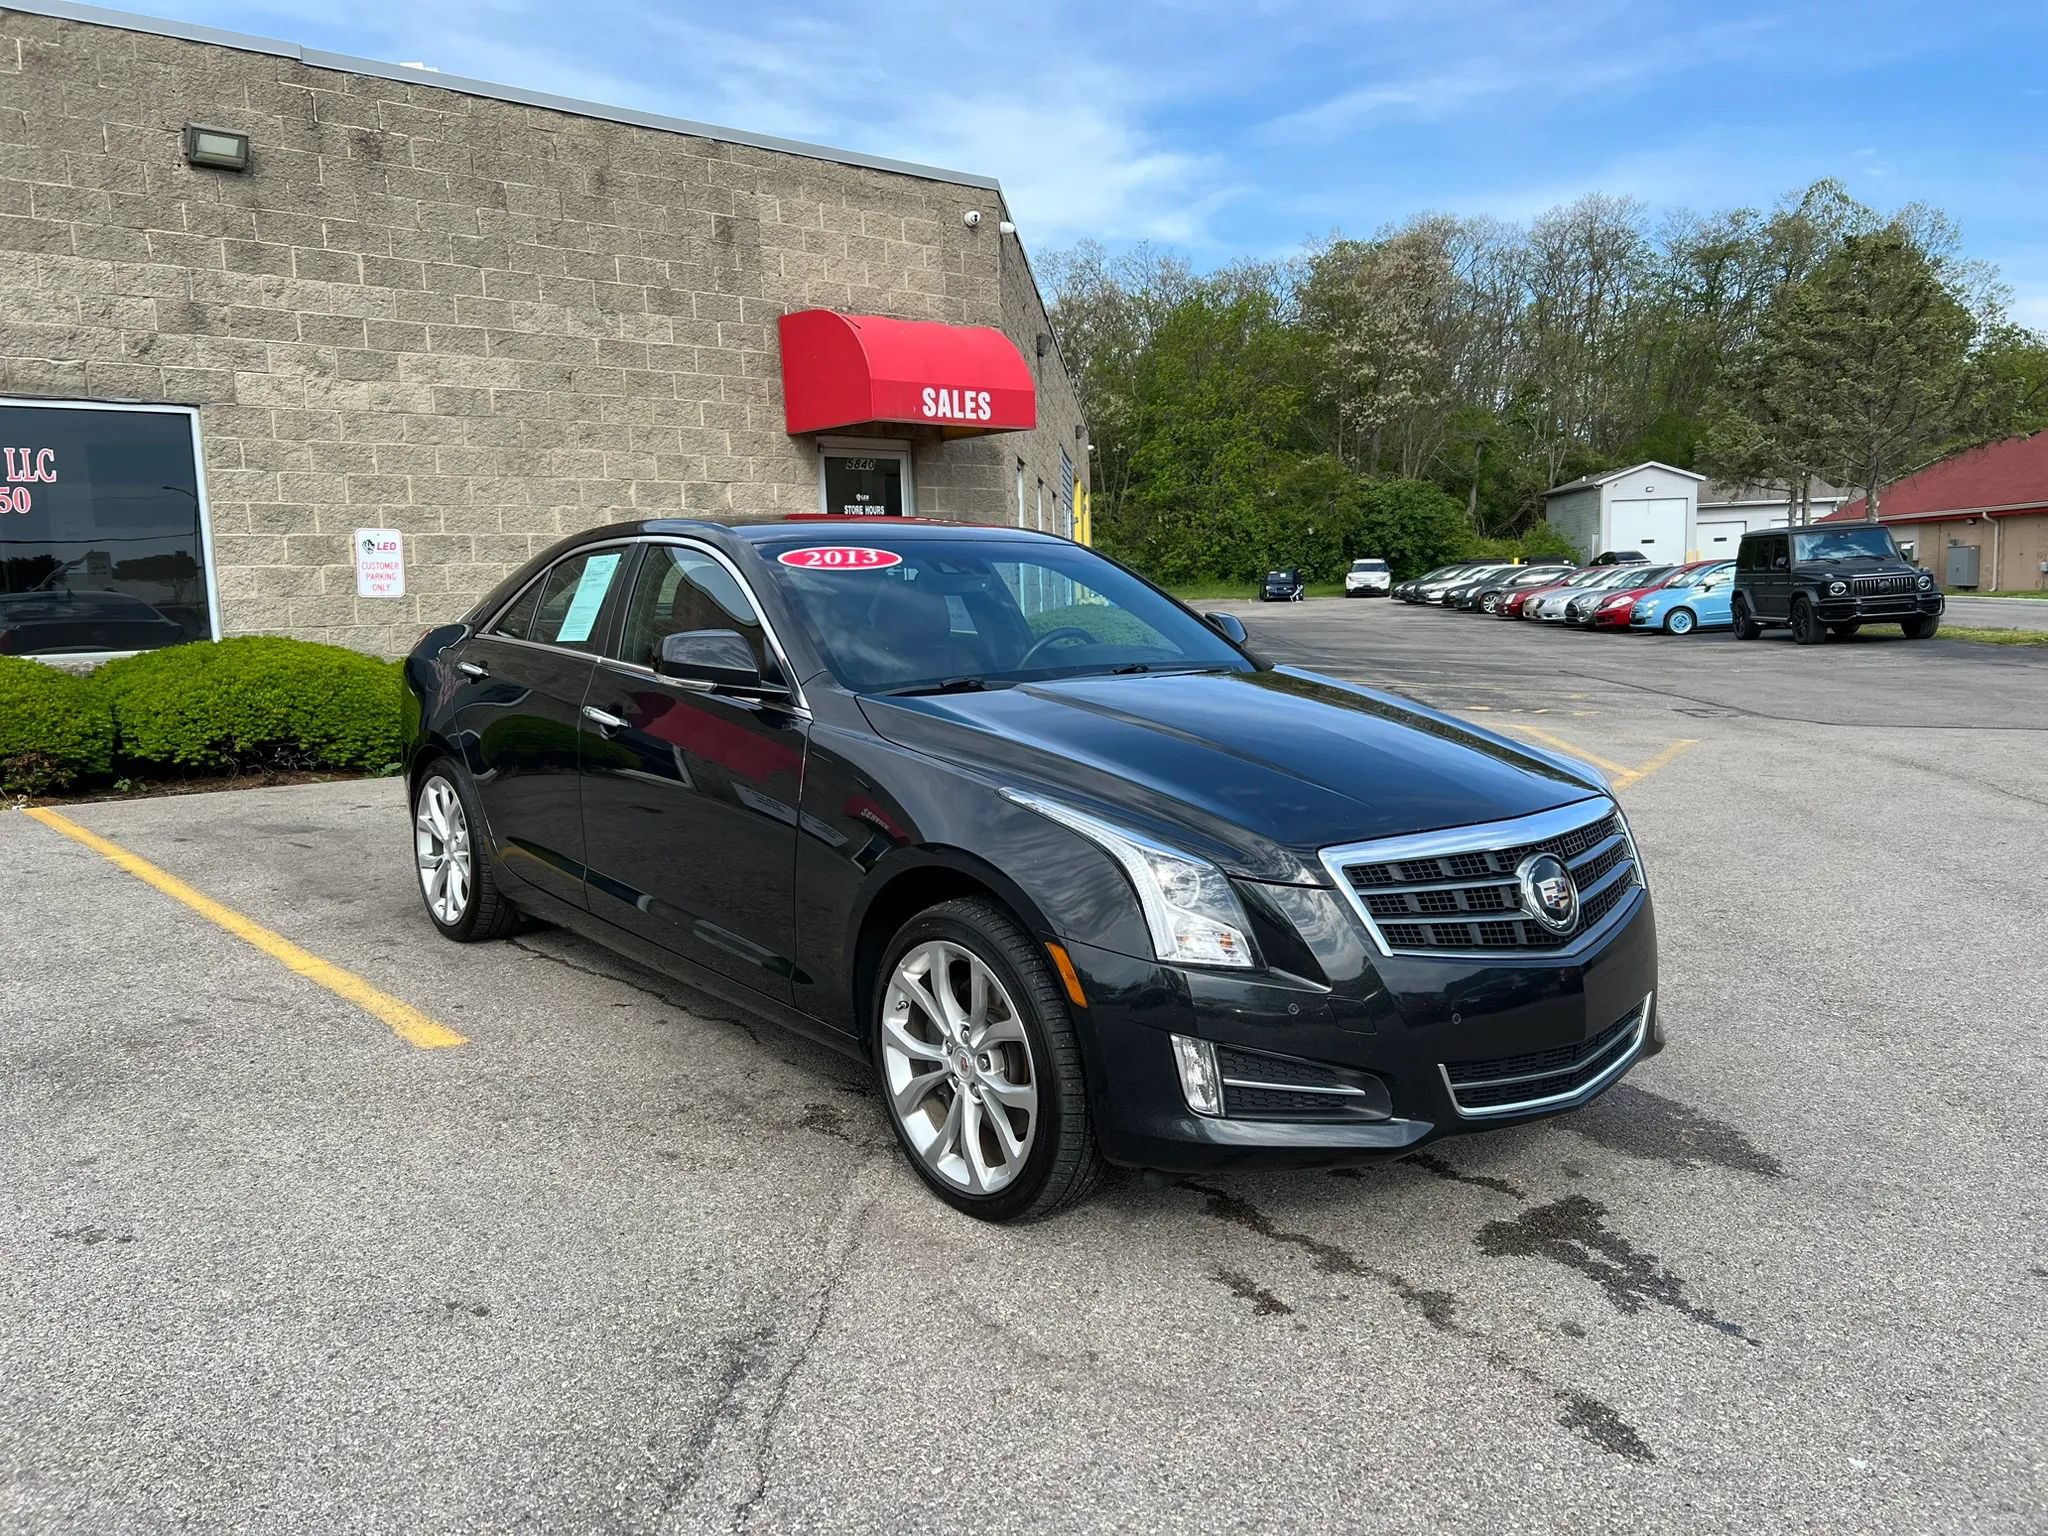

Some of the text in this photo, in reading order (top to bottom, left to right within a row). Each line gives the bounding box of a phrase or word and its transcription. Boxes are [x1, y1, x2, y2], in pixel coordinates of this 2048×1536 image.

[922, 387, 991, 420] SALES
[3, 447, 57, 483] LLC
[847, 458, 875, 469] 5840
[0, 486, 31, 514] 50
[844, 505, 885, 516] STORE HOURS
[376, 542, 397, 551] LEO
[804, 550, 879, 566] 2013
[361, 562, 400, 570] CUSTOMER
[366, 573, 397, 581] PARKING
[372, 583, 391, 592] ONLY
